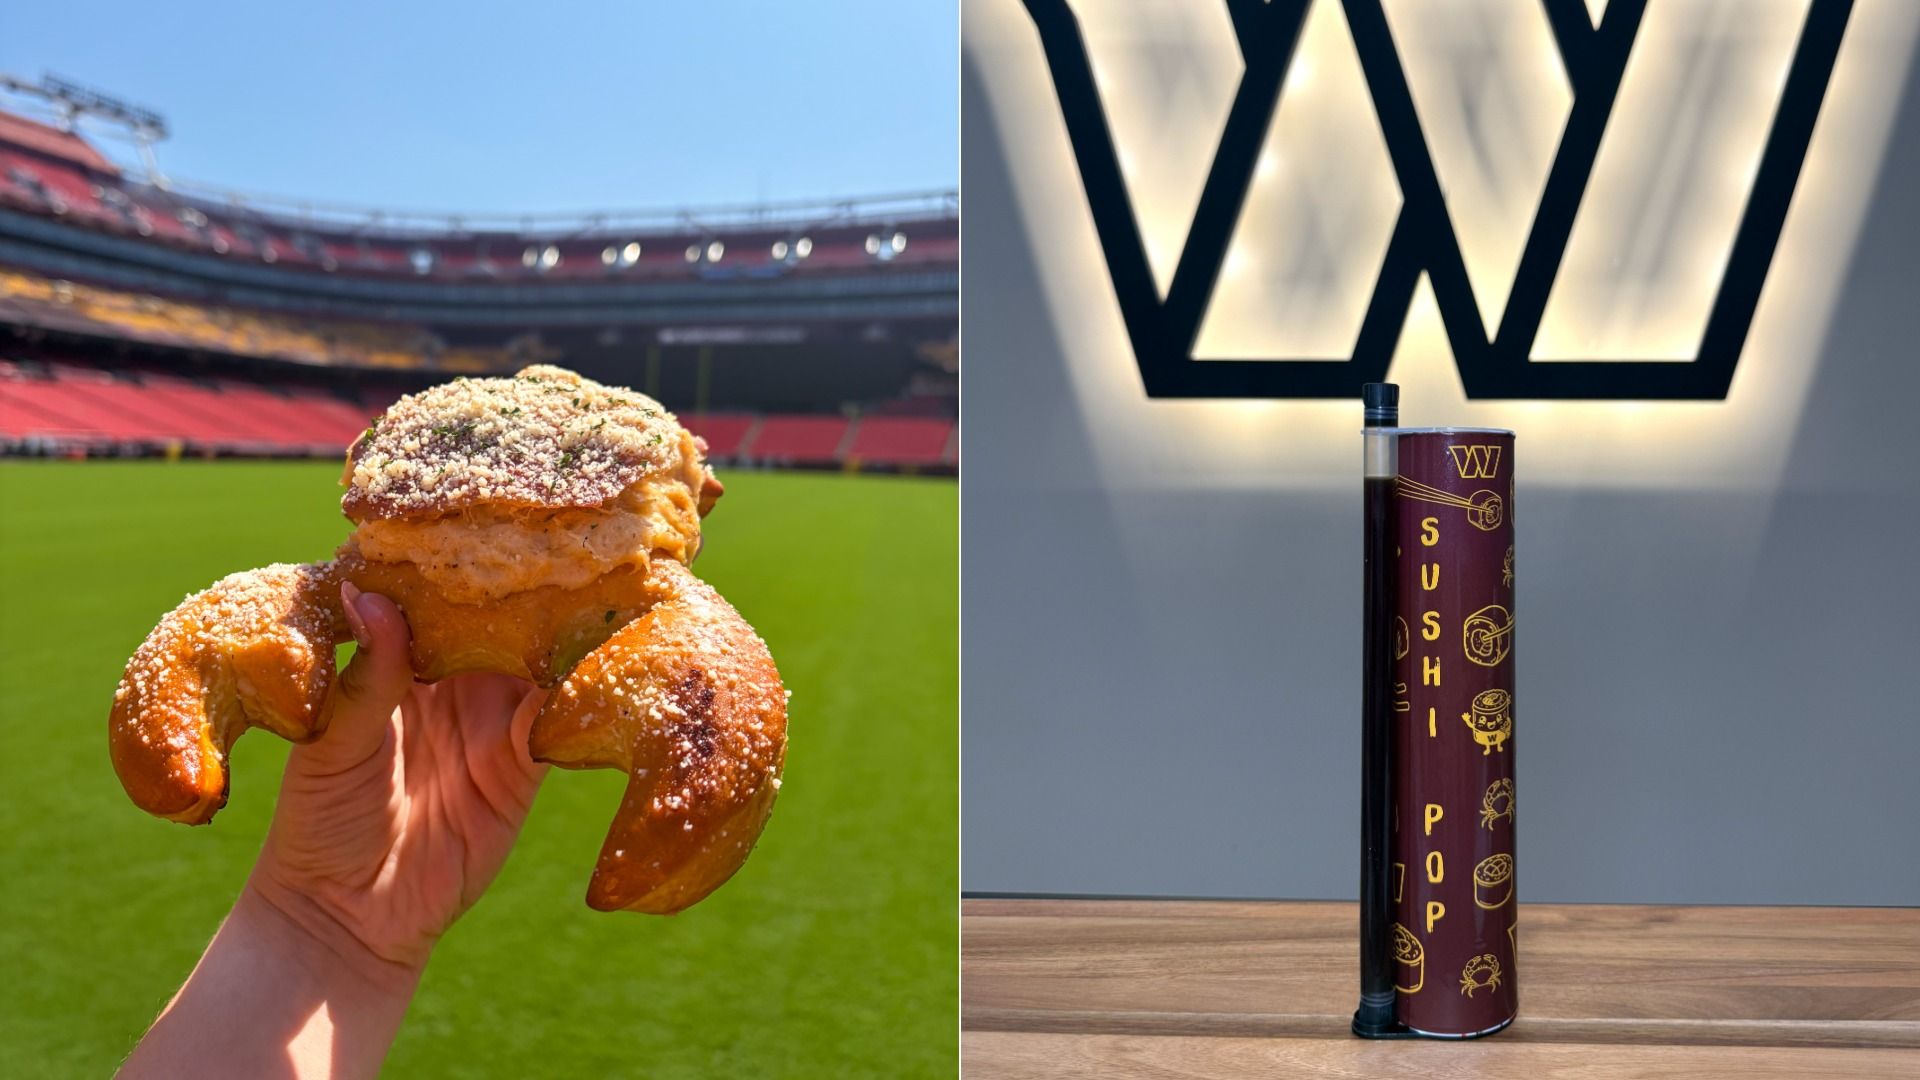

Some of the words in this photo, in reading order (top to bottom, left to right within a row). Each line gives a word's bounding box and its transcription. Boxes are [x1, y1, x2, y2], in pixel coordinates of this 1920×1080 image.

[1421, 517, 1441, 738] SUSHI
[1487, 734, 1497, 743] W
[1424, 804, 1446, 933] POP
